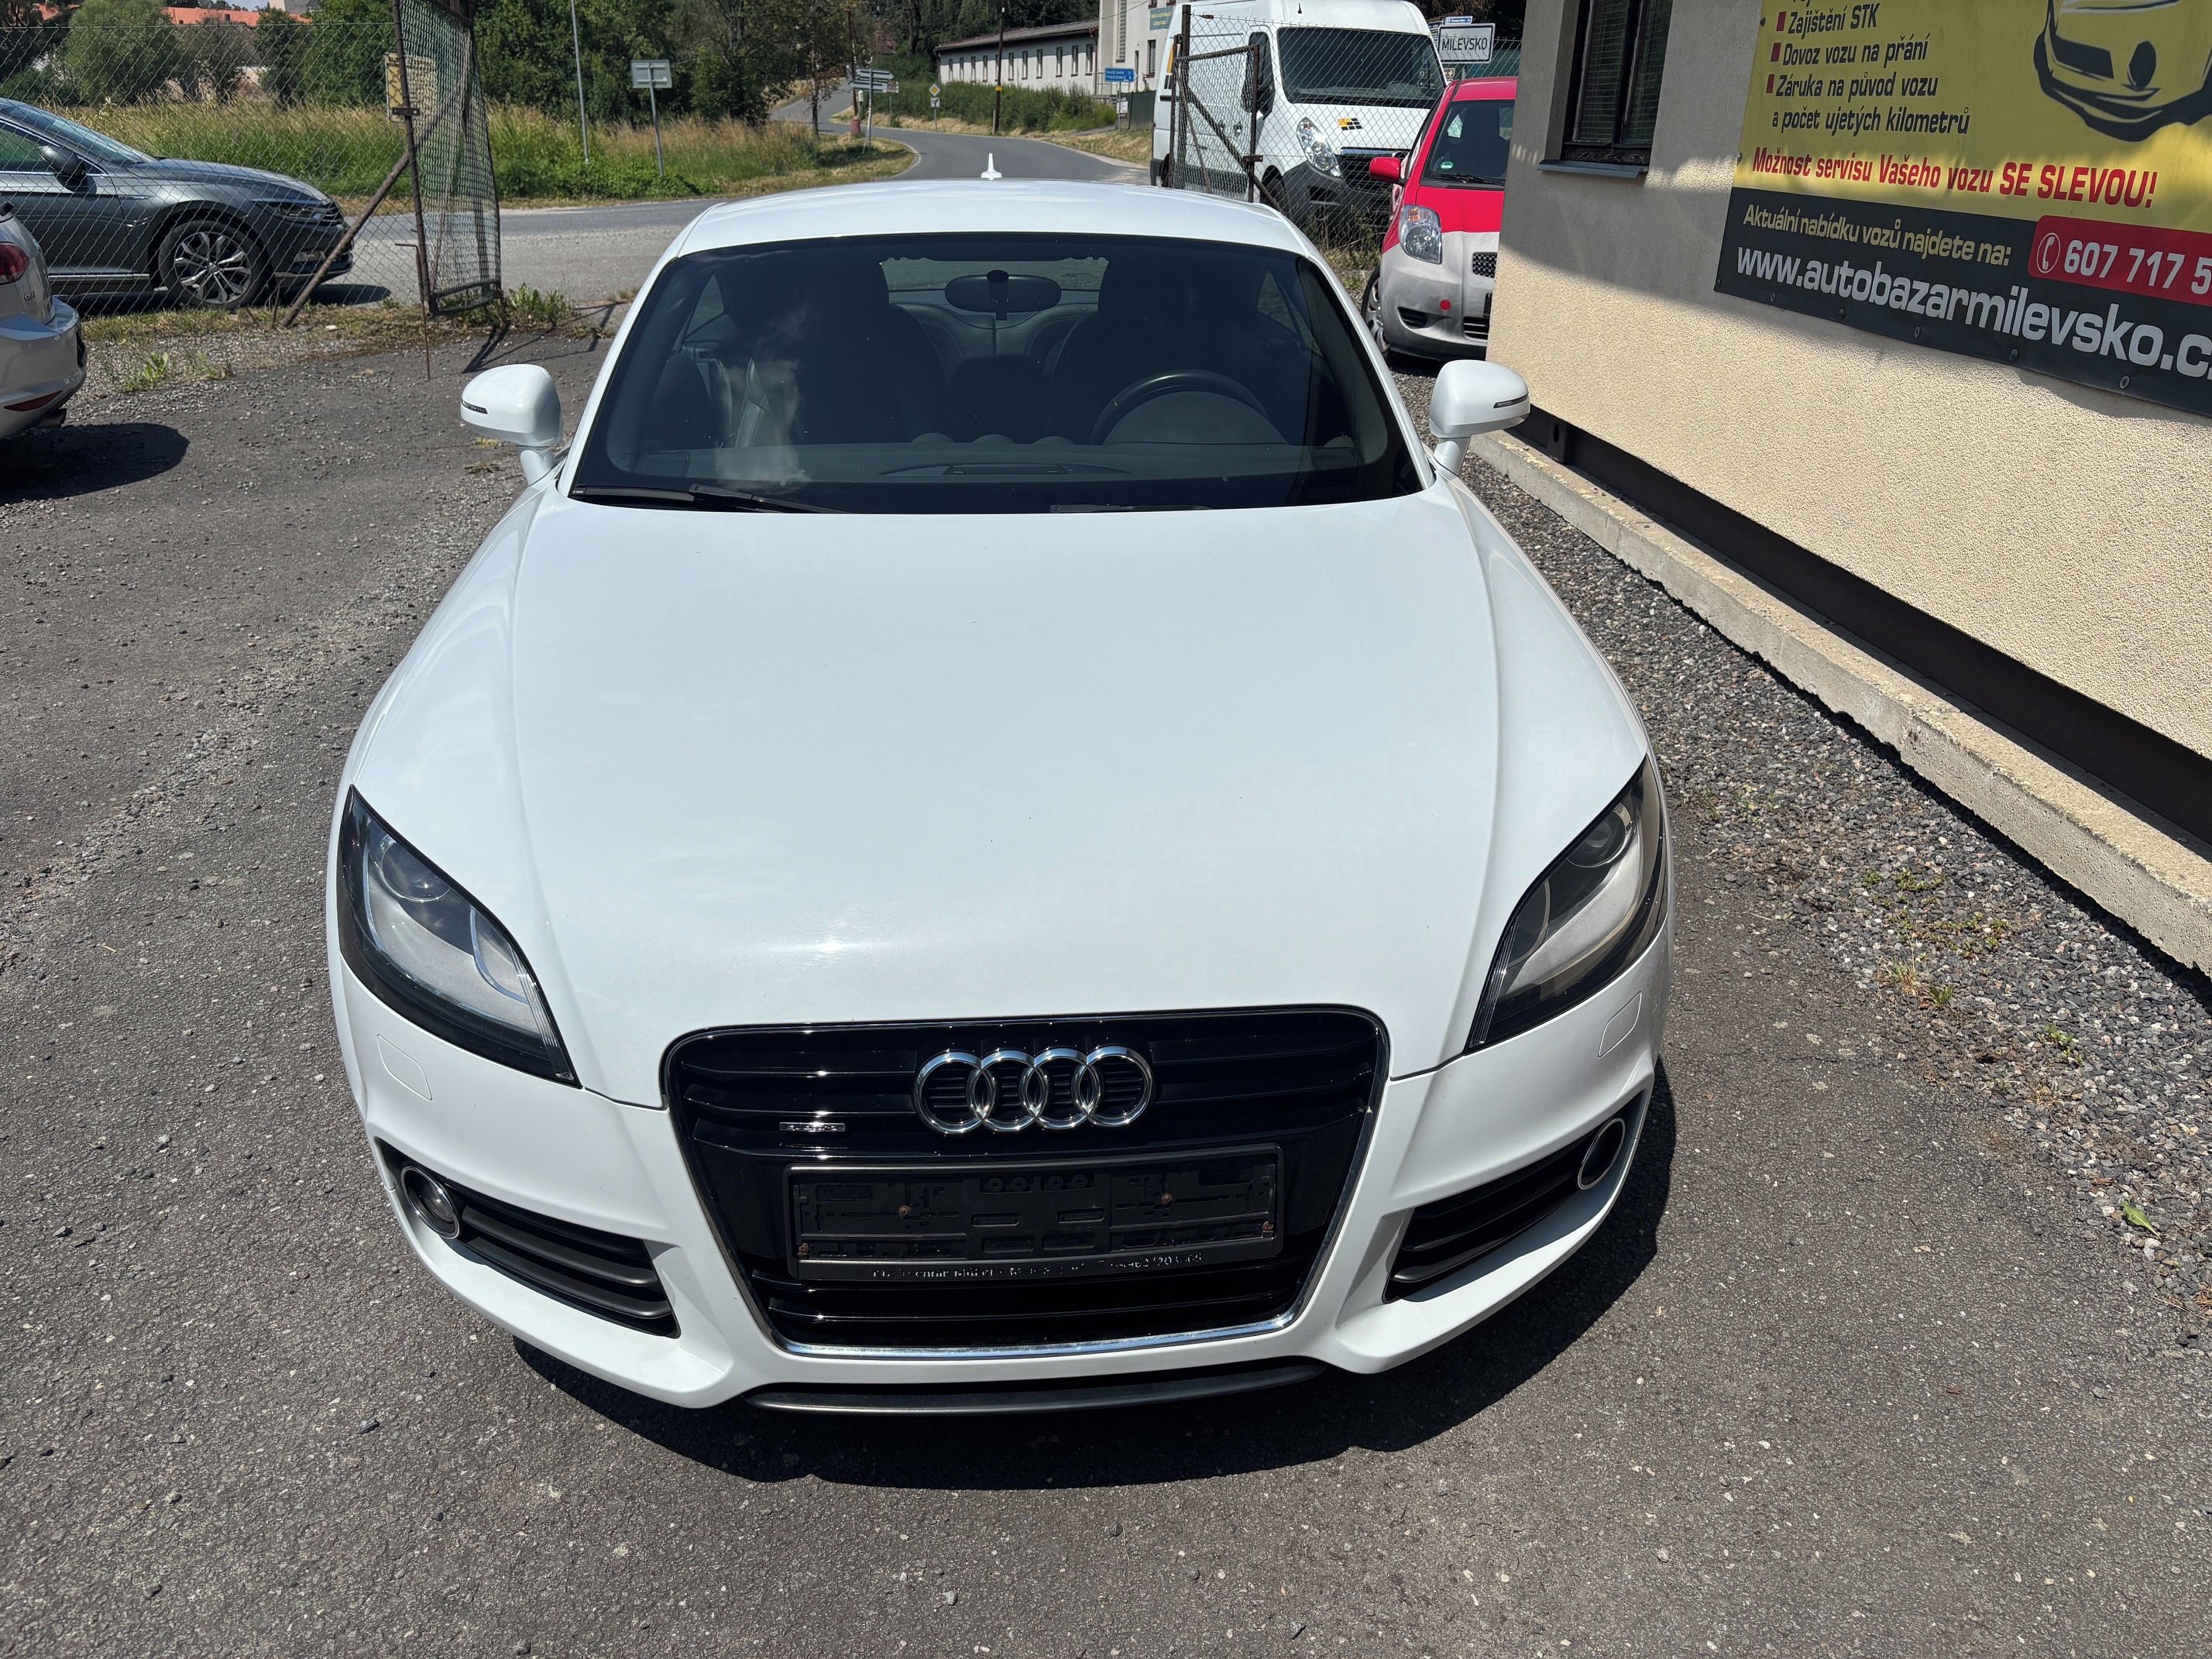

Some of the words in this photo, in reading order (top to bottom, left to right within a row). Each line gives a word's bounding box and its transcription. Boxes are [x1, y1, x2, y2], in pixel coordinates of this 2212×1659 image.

[1788, 5, 1848, 40] Zajištění
[1850, 3, 1881, 29] STK
[1441, 37, 1488, 51] MILEVSKO
[1782, 43, 1821, 66] Dovoz
[1826, 44, 1857, 64] vozu
[1860, 43, 1880, 63] na
[1884, 33, 1931, 68] přání
[1775, 73, 1823, 97] Záruka
[1827, 79, 1845, 97] na
[1848, 71, 1897, 103] původ
[1901, 77, 1939, 96] vozu
[1772, 111, 1778, 128] a
[1781, 105, 1821, 133] počet
[1825, 105, 1881, 136] ujetých
[1885, 106, 1970, 135] kilometrů
[1752, 146, 1812, 177] Možnost
[1815, 152, 1874, 182] servisu
[1878, 154, 1942, 188] Vašeho
[1947, 167, 1994, 193] vozu
[1999, 161, 2033, 198] SE
[2037, 164, 2158, 209] SLEVOU!
[1743, 204, 1801, 233] Aktuální
[1799, 212, 1860, 242] nabídku
[1862, 218, 1901, 249] vozů
[1902, 227, 1975, 261] najdete
[1977, 242, 2012, 266] na:
[2064, 239, 2119, 279] 607
[2126, 247, 2185, 290] 717
[2190, 256, 2212, 294] 5
[1737, 246, 2212, 380] www.autobazarmilevsko.c
